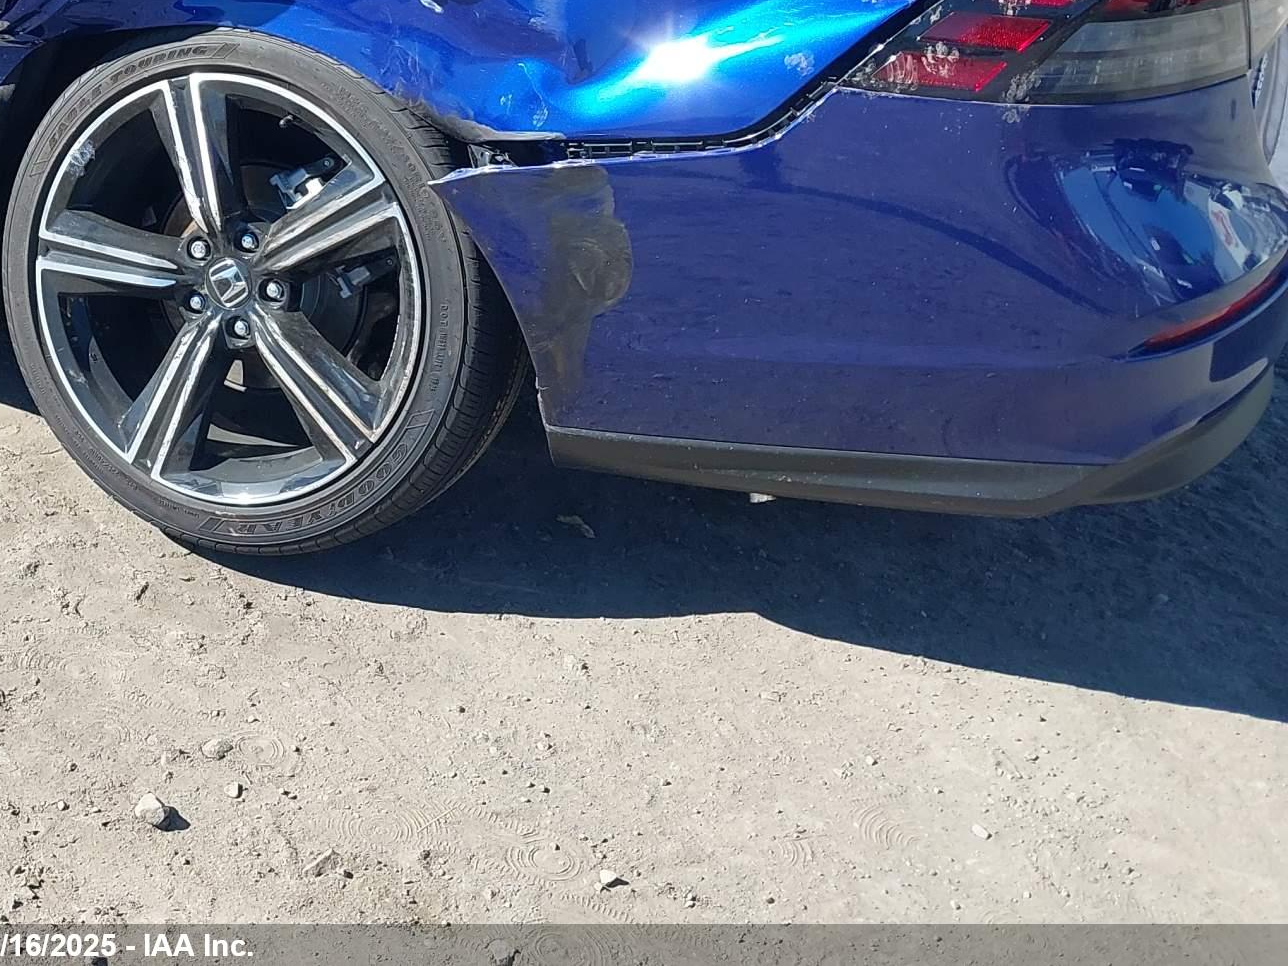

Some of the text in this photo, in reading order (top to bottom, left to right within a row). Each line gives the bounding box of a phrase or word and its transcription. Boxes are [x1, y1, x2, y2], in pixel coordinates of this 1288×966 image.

[48, 44, 209, 151] EAGLE TOURING
[236, 442, 409, 536] GOODYEAR
